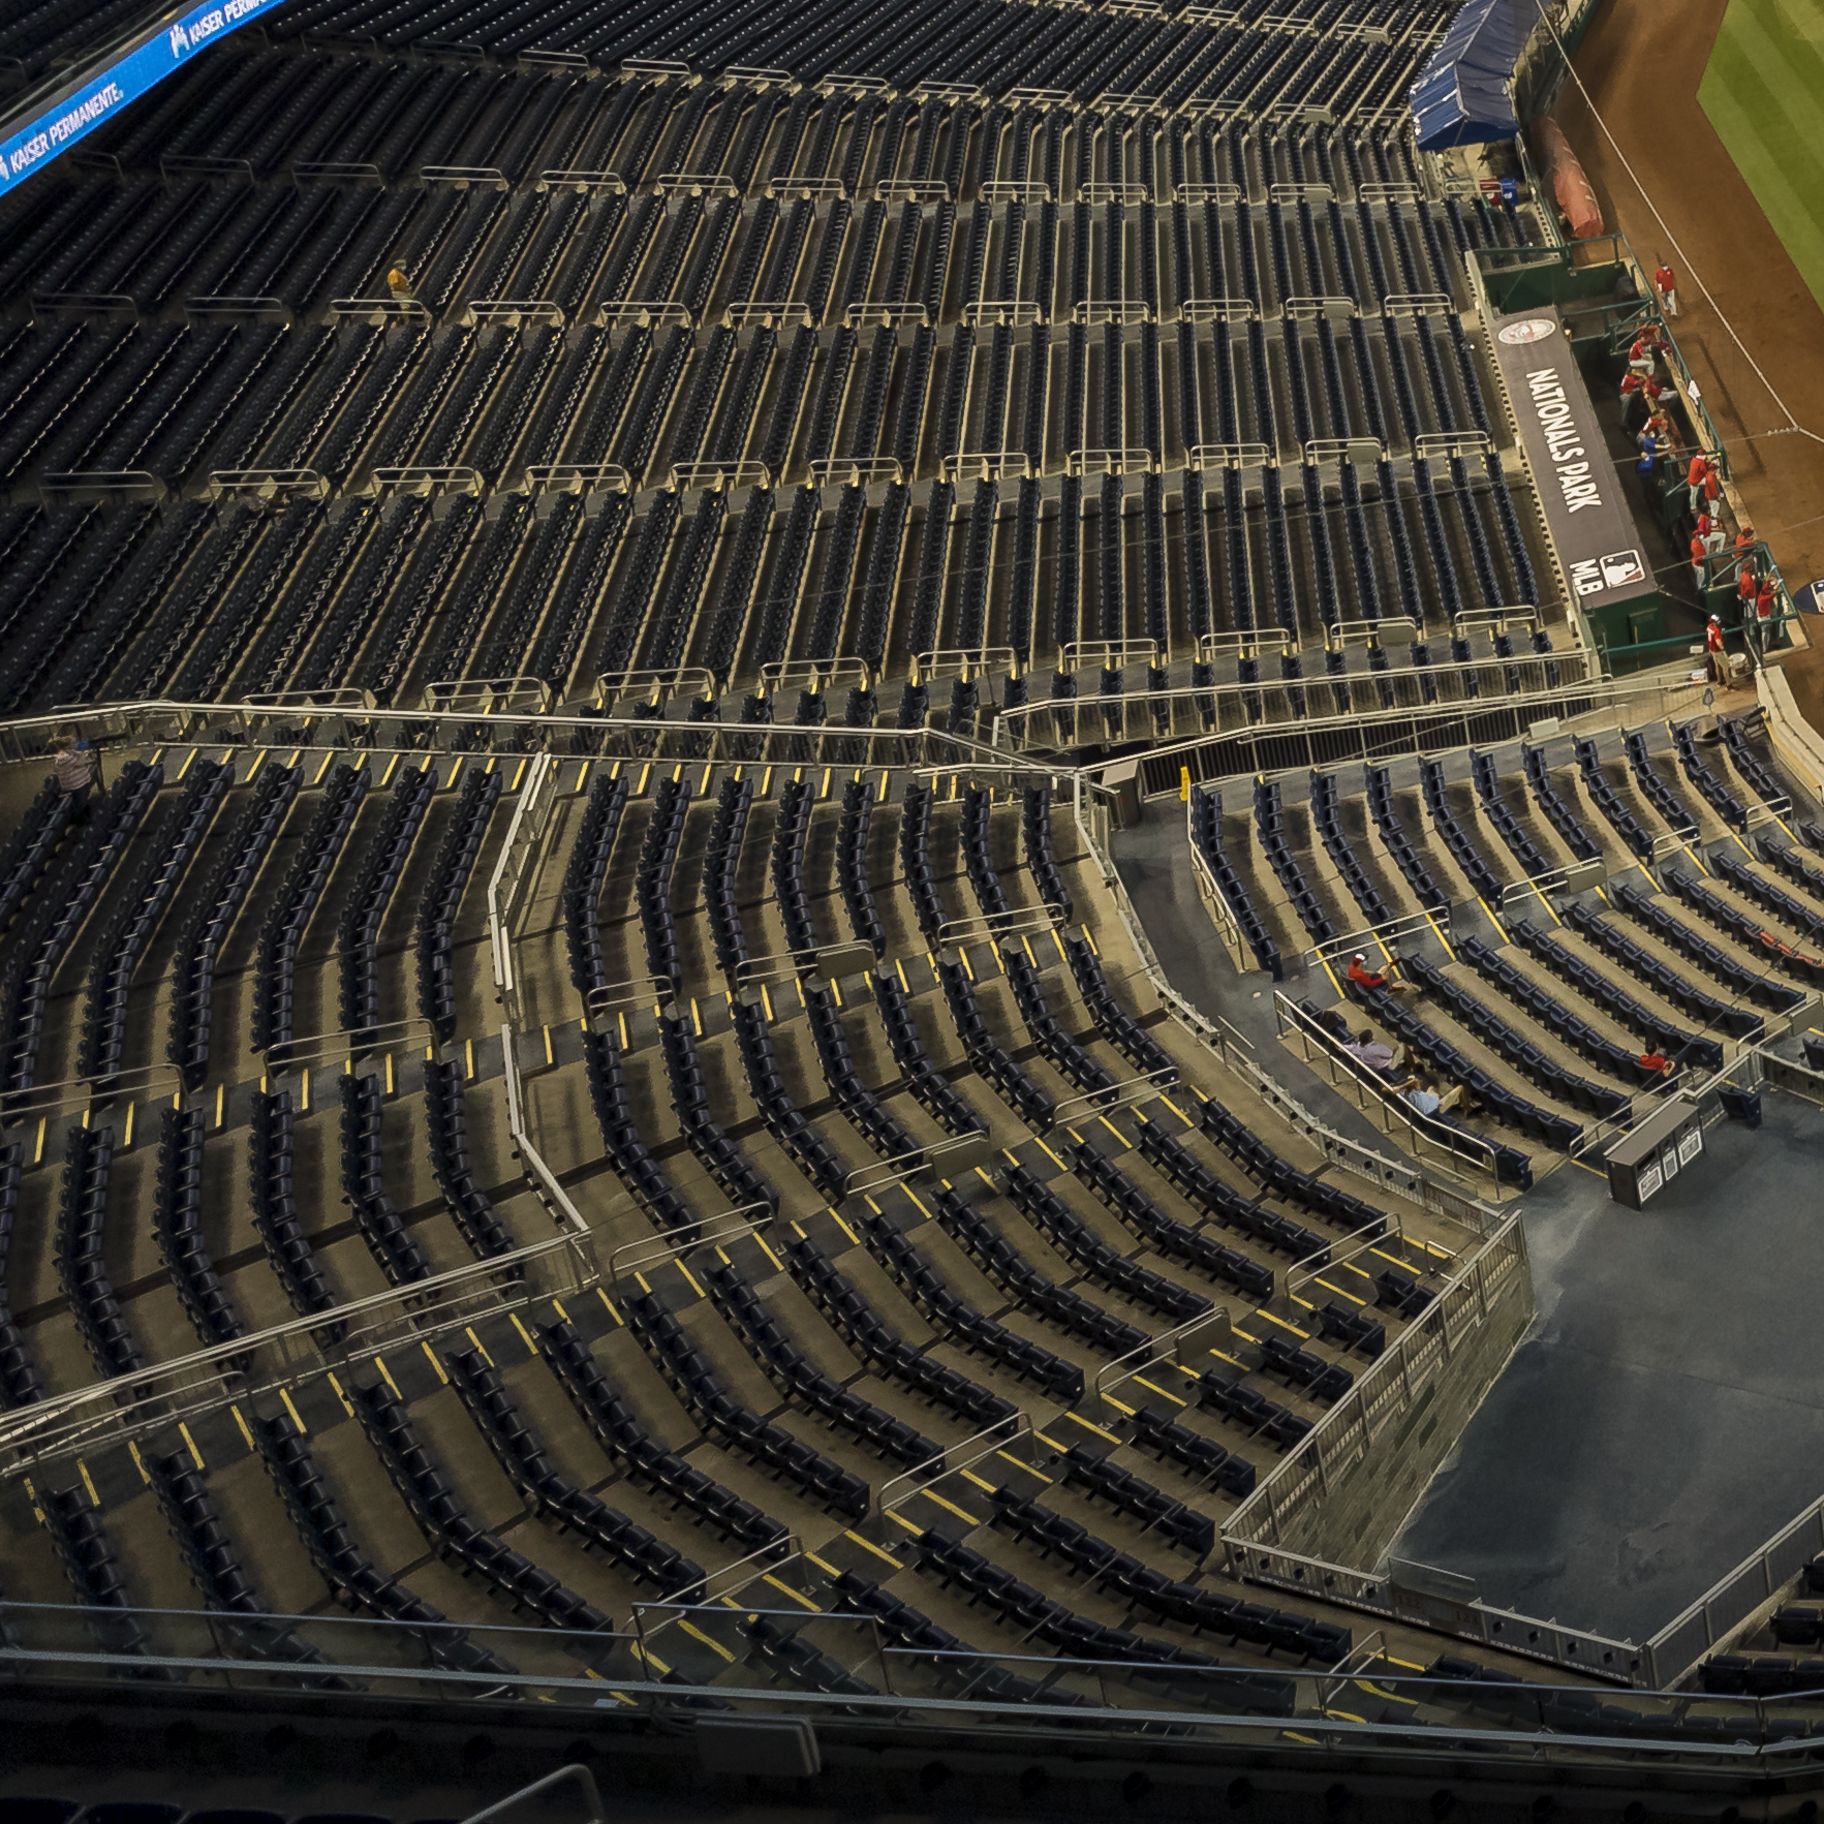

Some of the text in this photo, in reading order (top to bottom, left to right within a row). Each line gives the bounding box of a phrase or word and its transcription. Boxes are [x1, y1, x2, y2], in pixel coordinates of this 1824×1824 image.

[188, 10, 225, 46] KAISER
[9, 130, 49, 173] KAISER
[1526, 367, 1603, 514] NATIONALS PARK
[1569, 558, 1605, 597] MLB
